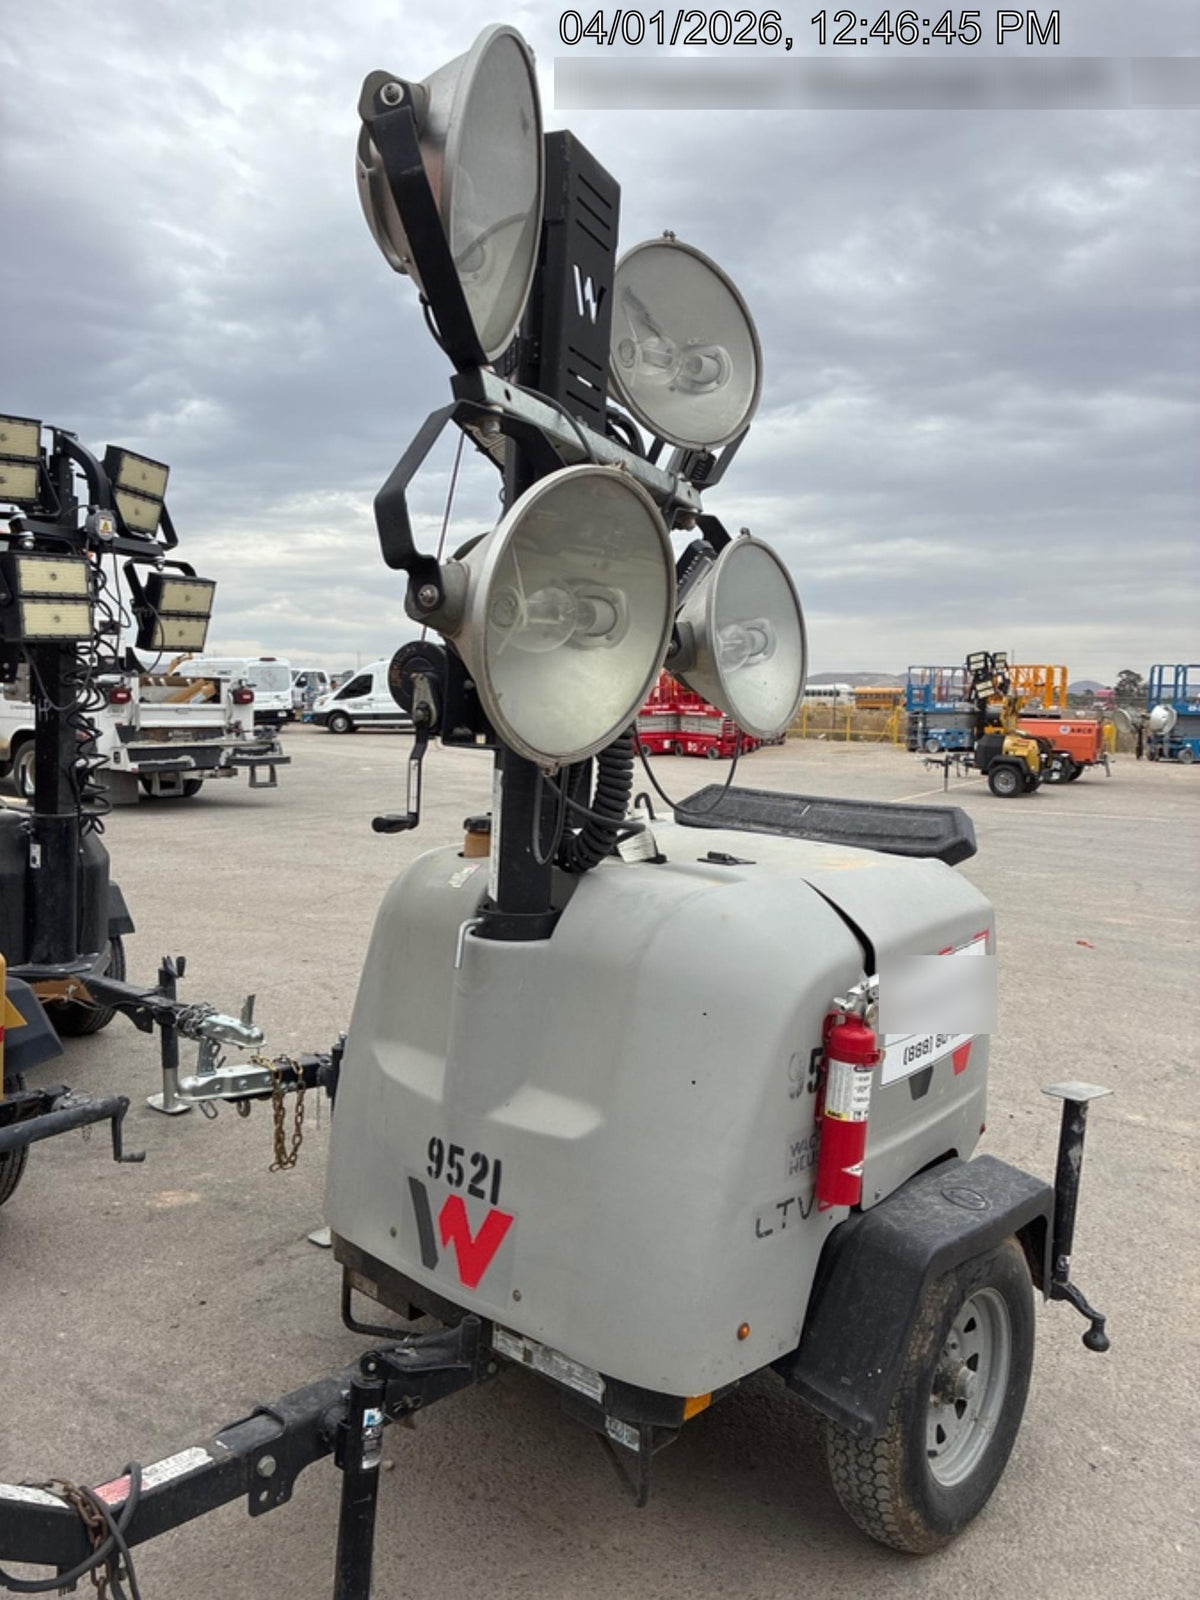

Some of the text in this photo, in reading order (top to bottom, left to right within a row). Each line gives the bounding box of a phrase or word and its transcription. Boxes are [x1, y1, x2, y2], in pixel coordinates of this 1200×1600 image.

[788, 1047, 823, 1100] 95
[903, 1035, 933, 1066] (888)
[427, 1136, 502, 1206] 9521
[756, 1187, 815, 1239] LTV
